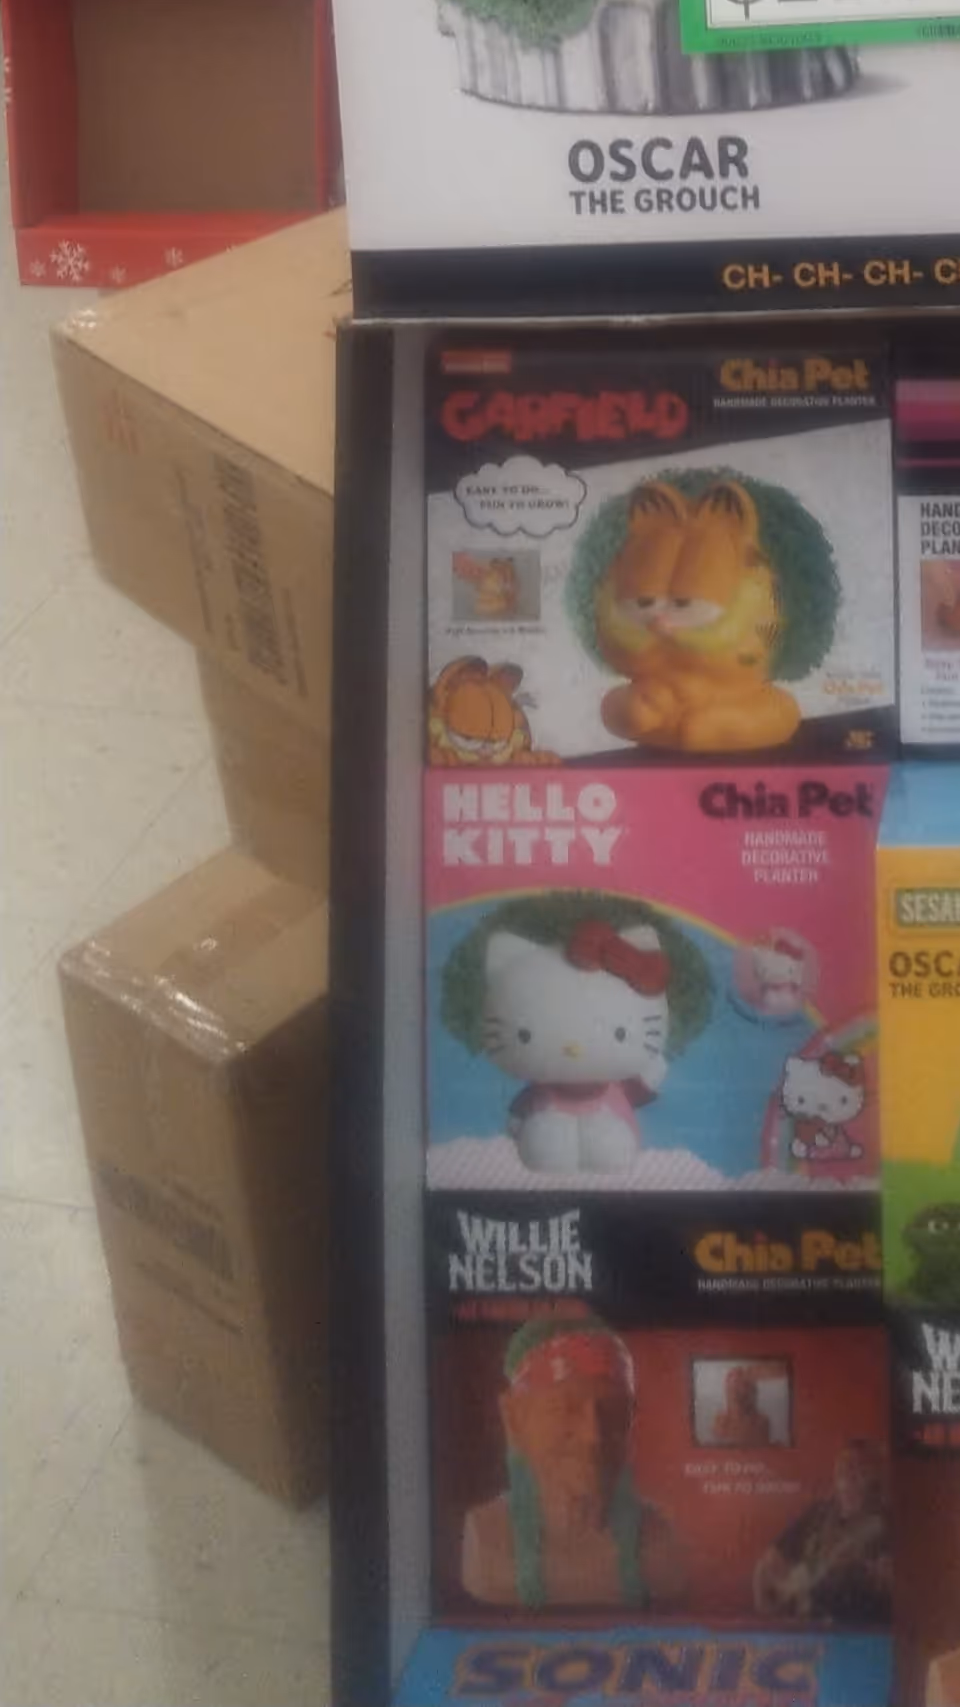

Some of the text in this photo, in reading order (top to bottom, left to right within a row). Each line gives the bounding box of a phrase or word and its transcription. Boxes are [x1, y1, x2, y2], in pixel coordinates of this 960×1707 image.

[568, 135, 750, 183] OSCAR
[568, 184, 761, 216] THE GROUCH
[722, 262, 784, 290] CH-
[793, 260, 854, 288] CH-
[863, 258, 925, 286] CH-
[719, 356, 871, 392] Chia Pet
[440, 388, 690, 443] GARFIELD
[443, 782, 618, 822] HELLO
[699, 780, 875, 819] Chia Pet
[443, 825, 623, 866] KITTY
[741, 848, 831, 865] DECORATIVE
[743, 831, 828, 848] HANDMADE
[753, 867, 819, 883] PLANTER
[888, 982, 923, 999] THE
[457, 1208, 581, 1254] WILLIE
[448, 1252, 593, 1291] NELSON
[694, 1231, 882, 1273] Chia Pet
[455, 1641, 822, 1696] SONIC
